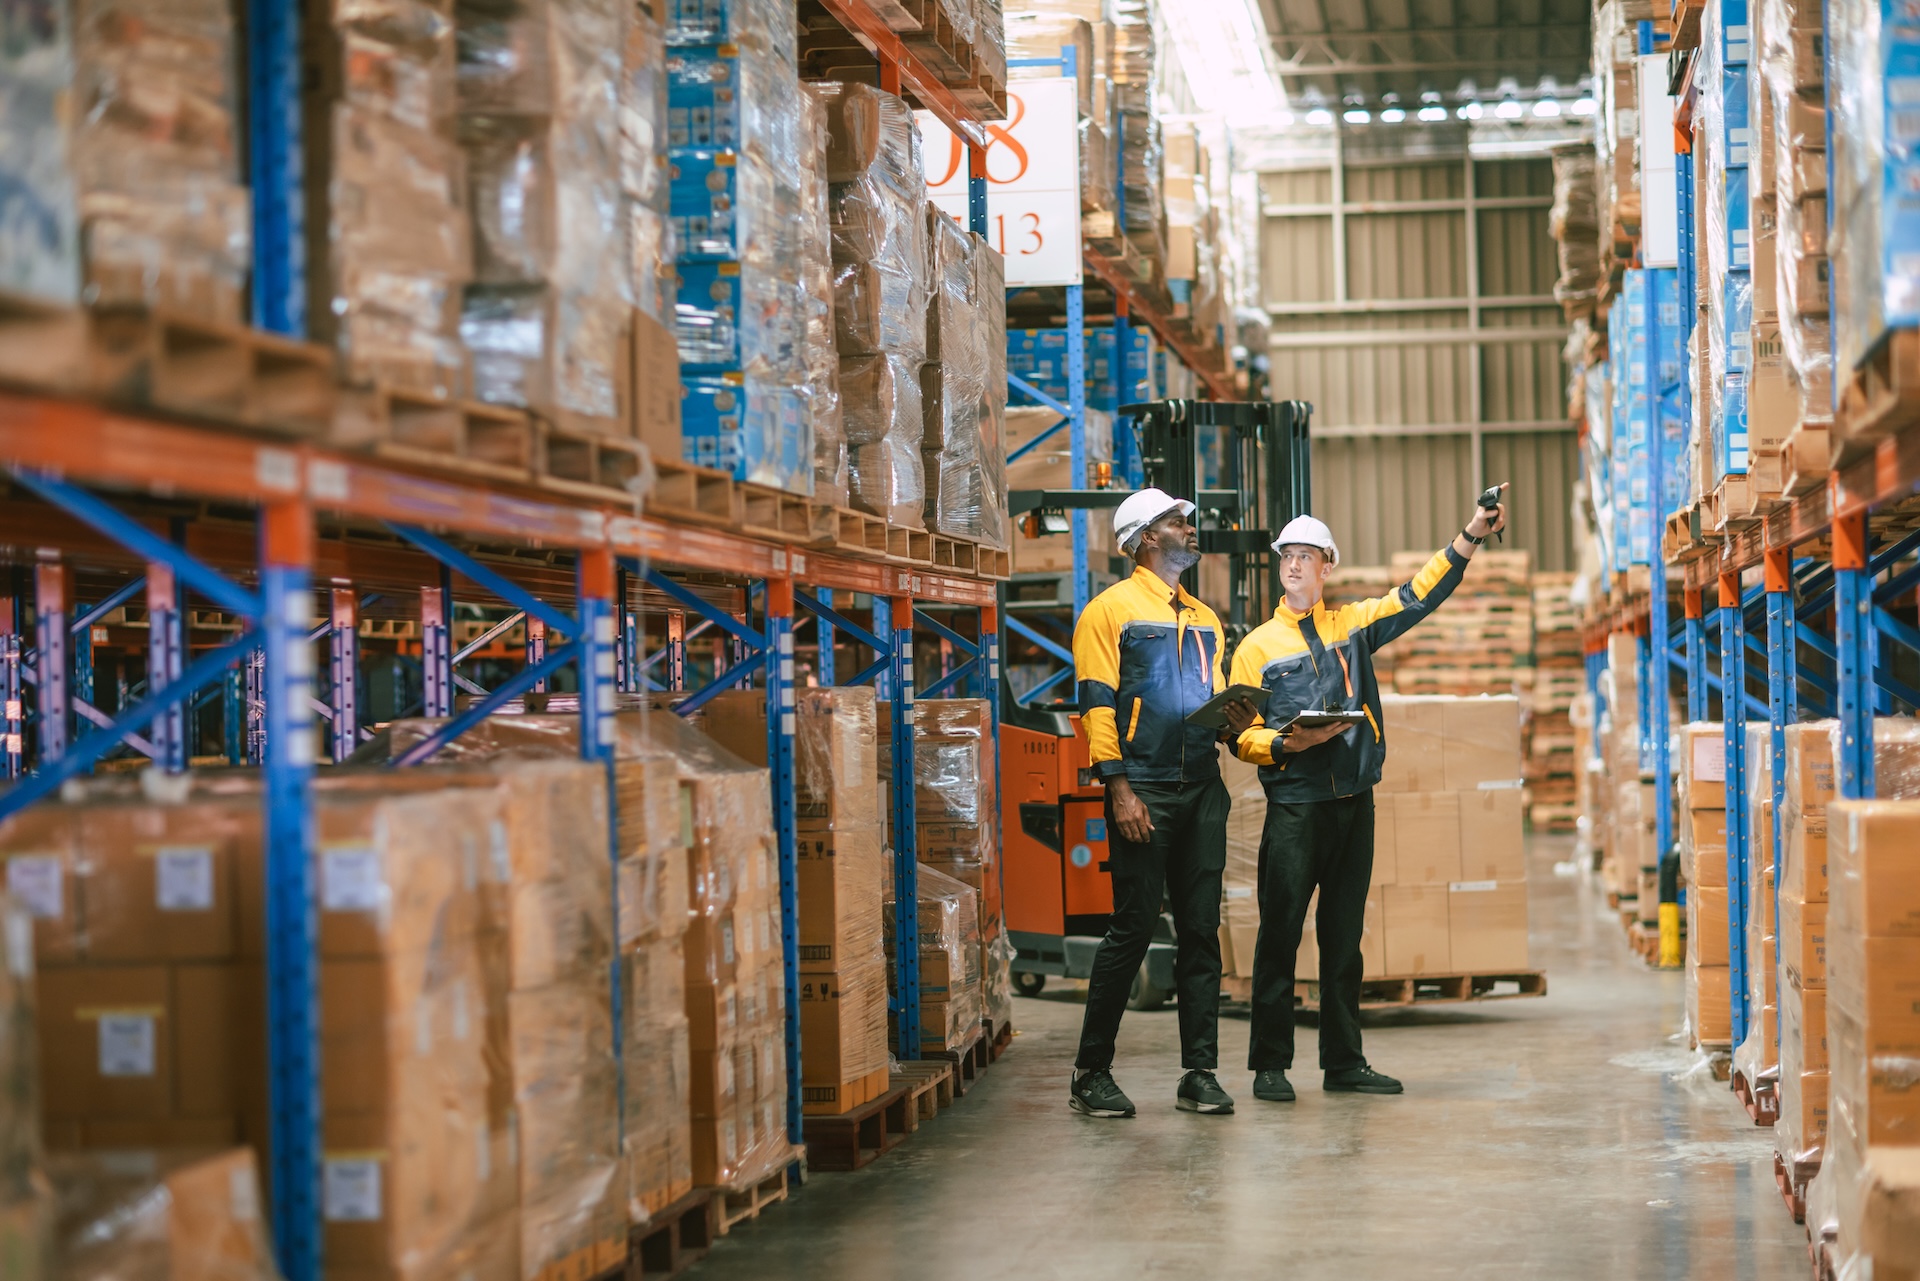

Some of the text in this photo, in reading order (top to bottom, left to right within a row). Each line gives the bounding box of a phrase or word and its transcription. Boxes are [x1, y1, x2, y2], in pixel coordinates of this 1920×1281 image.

[992, 212, 1044, 256] 13
[1024, 741, 1055, 754] 18012
[802, 983, 813, 993] 4
